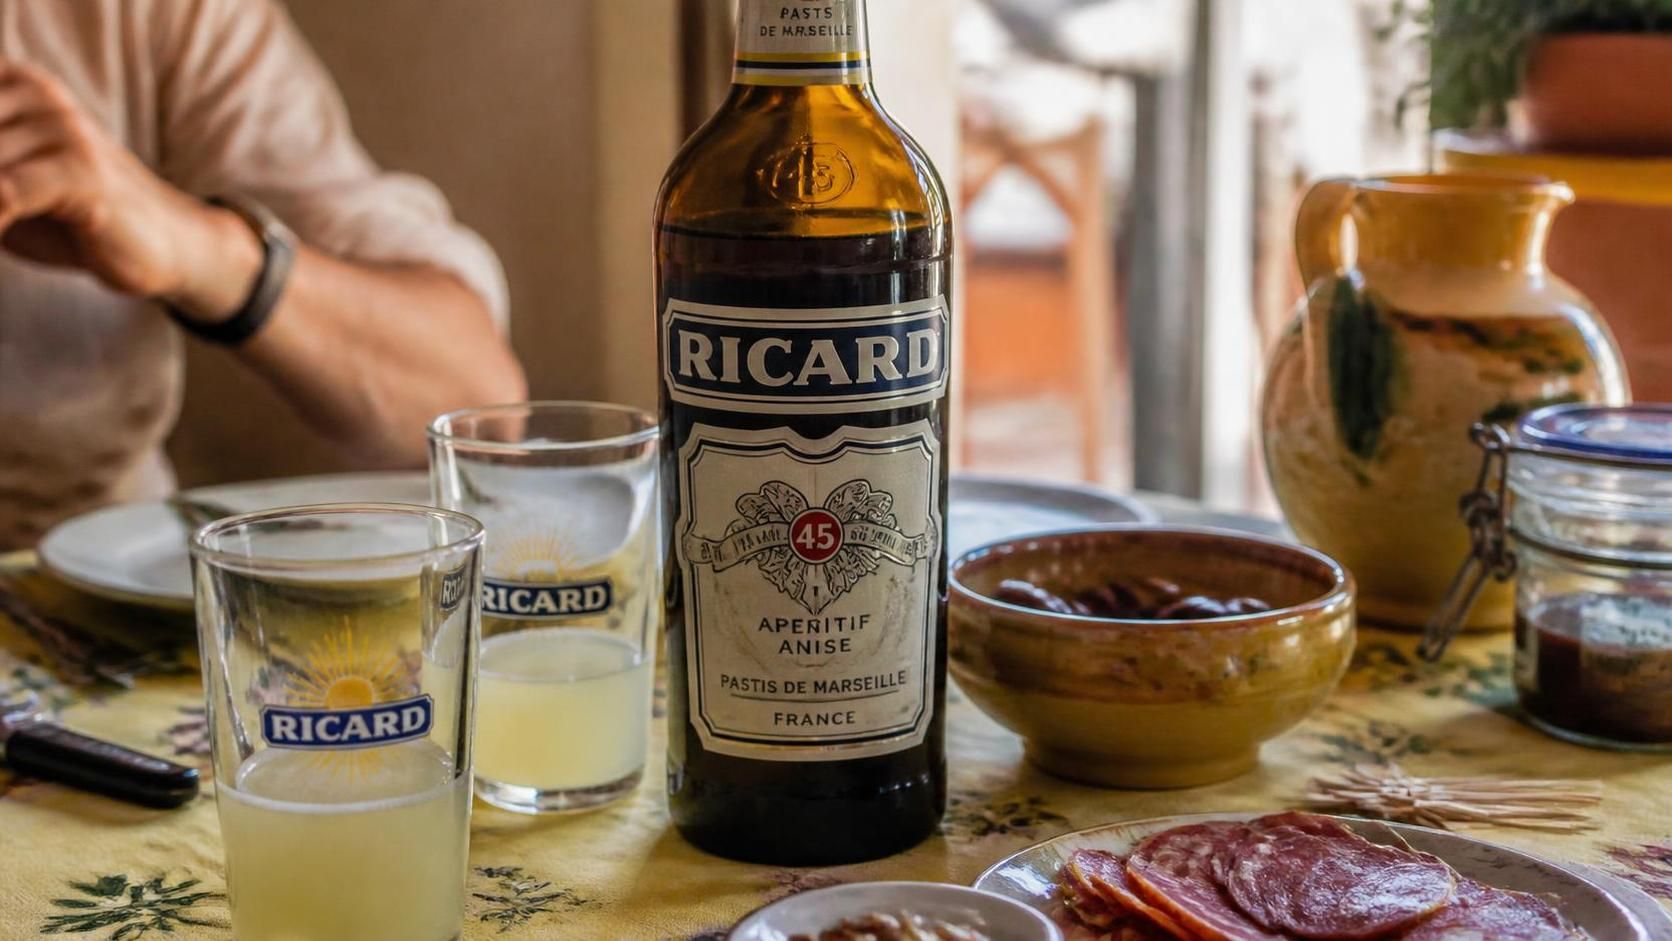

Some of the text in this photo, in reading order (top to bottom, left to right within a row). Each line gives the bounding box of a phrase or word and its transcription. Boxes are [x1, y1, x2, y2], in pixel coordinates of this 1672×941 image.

[760, 26, 776, 37] DE
[677, 328, 940, 387] RICARD
[796, 523, 835, 549] 45
[482, 585, 607, 614] RICARD
[778, 638, 852, 655] ANISE
[720, 670, 906, 694] PASTIS DE MARSEILLE
[271, 706, 426, 742] RICARD
[773, 711, 857, 726] FRANCE
